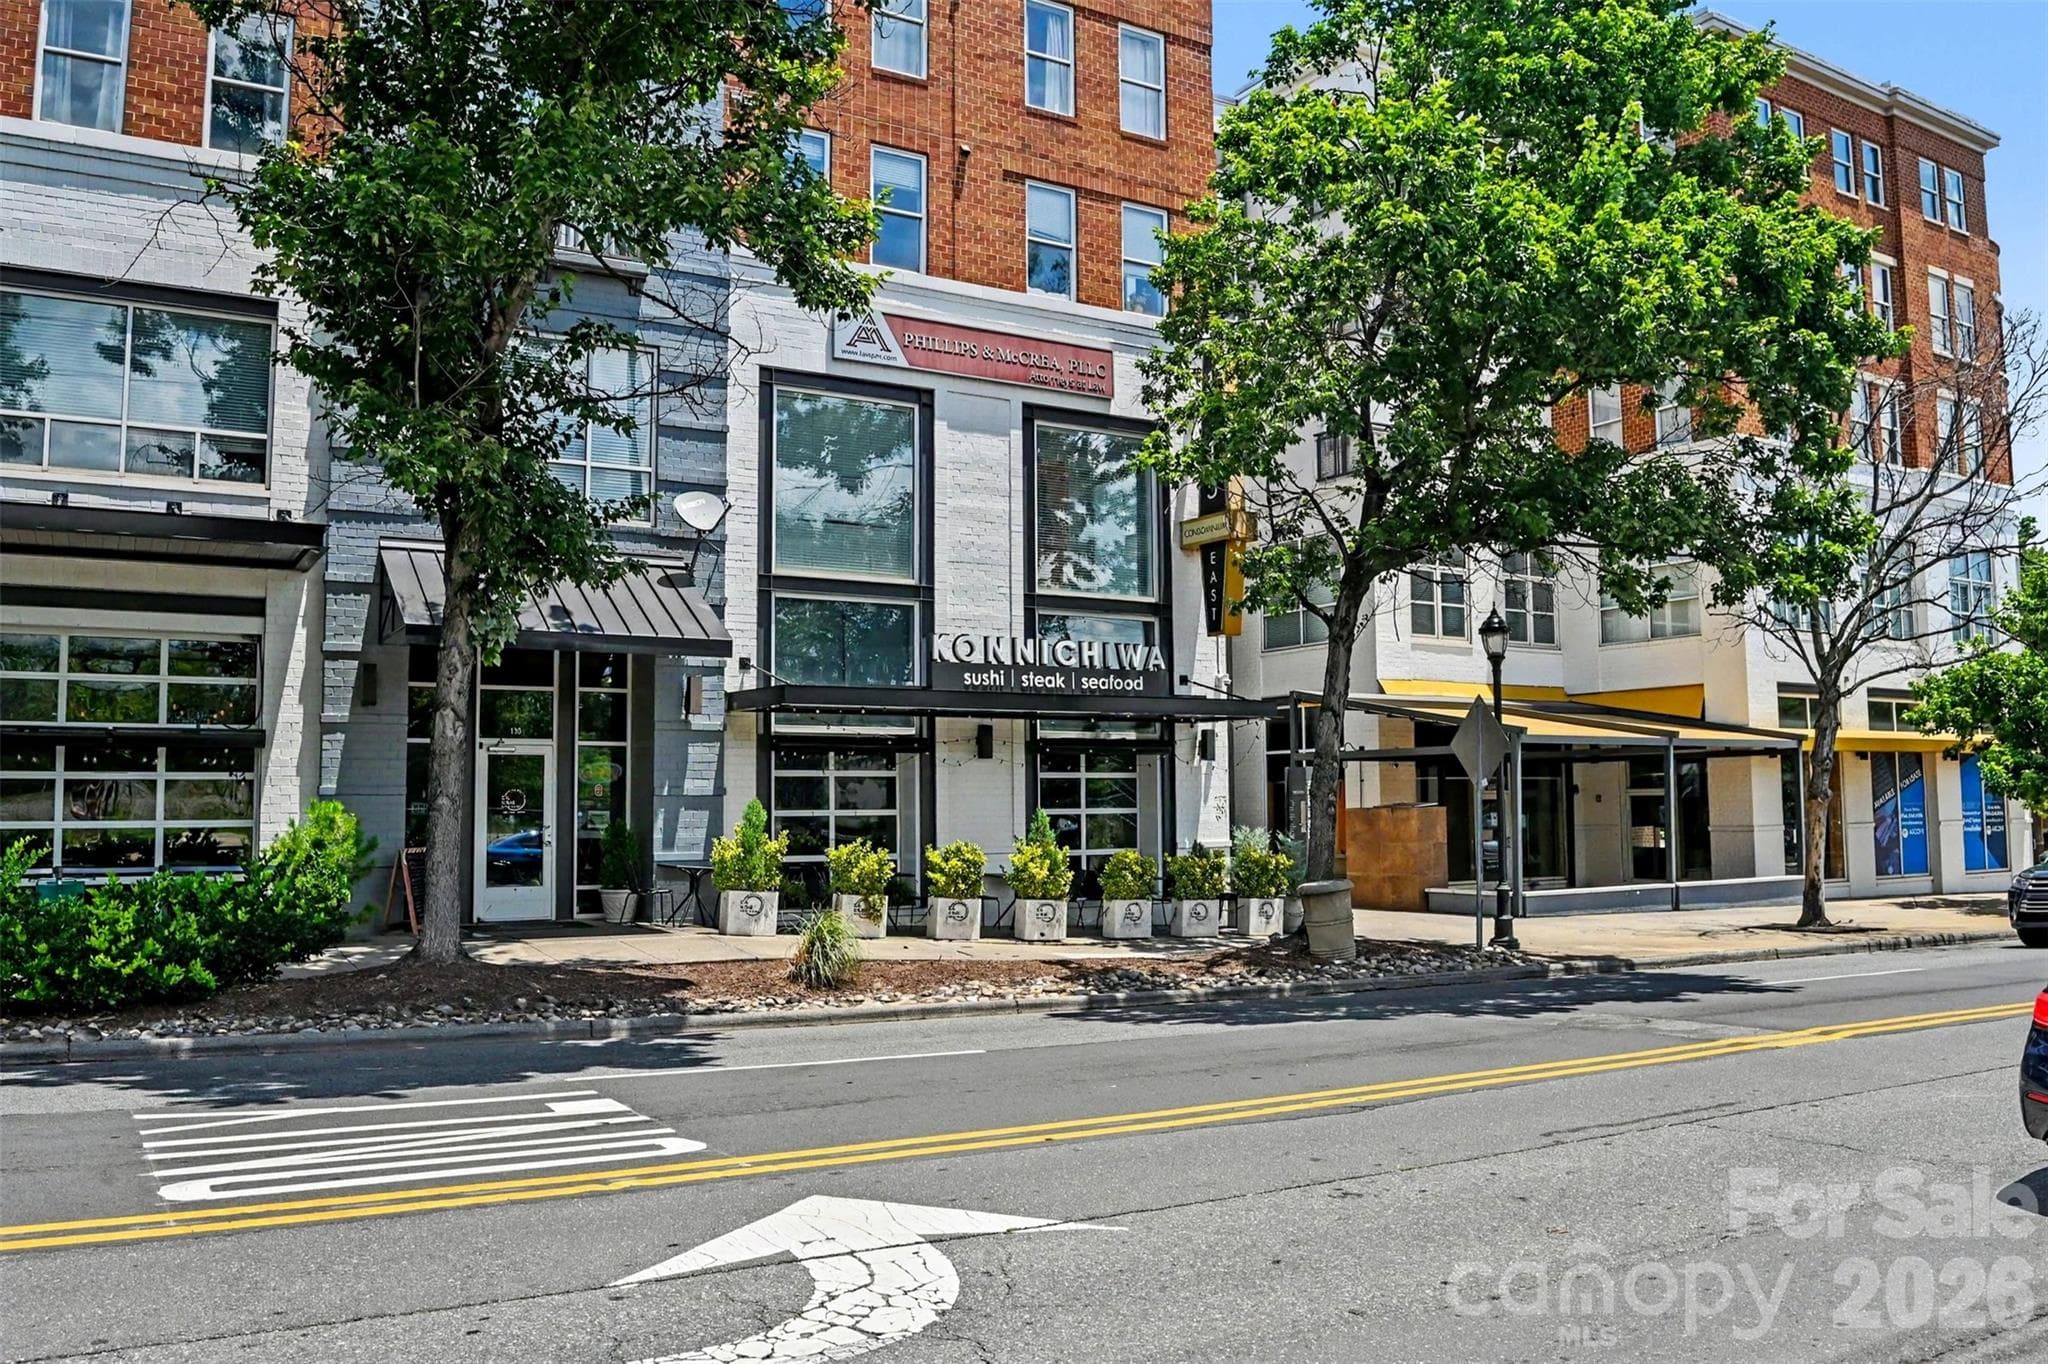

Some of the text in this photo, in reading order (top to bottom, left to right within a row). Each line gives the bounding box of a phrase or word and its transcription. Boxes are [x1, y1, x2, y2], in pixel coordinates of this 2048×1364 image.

[902, 332, 1106, 379] PHILLIPS & McCREA, PLLC
[1029, 370, 1106, 393] Attorneys at Law
[1209, 551, 1218, 621] EAST
[933, 633, 1166, 671] KONNICHIWA
[963, 669, 1144, 692] sushi steak seafood
